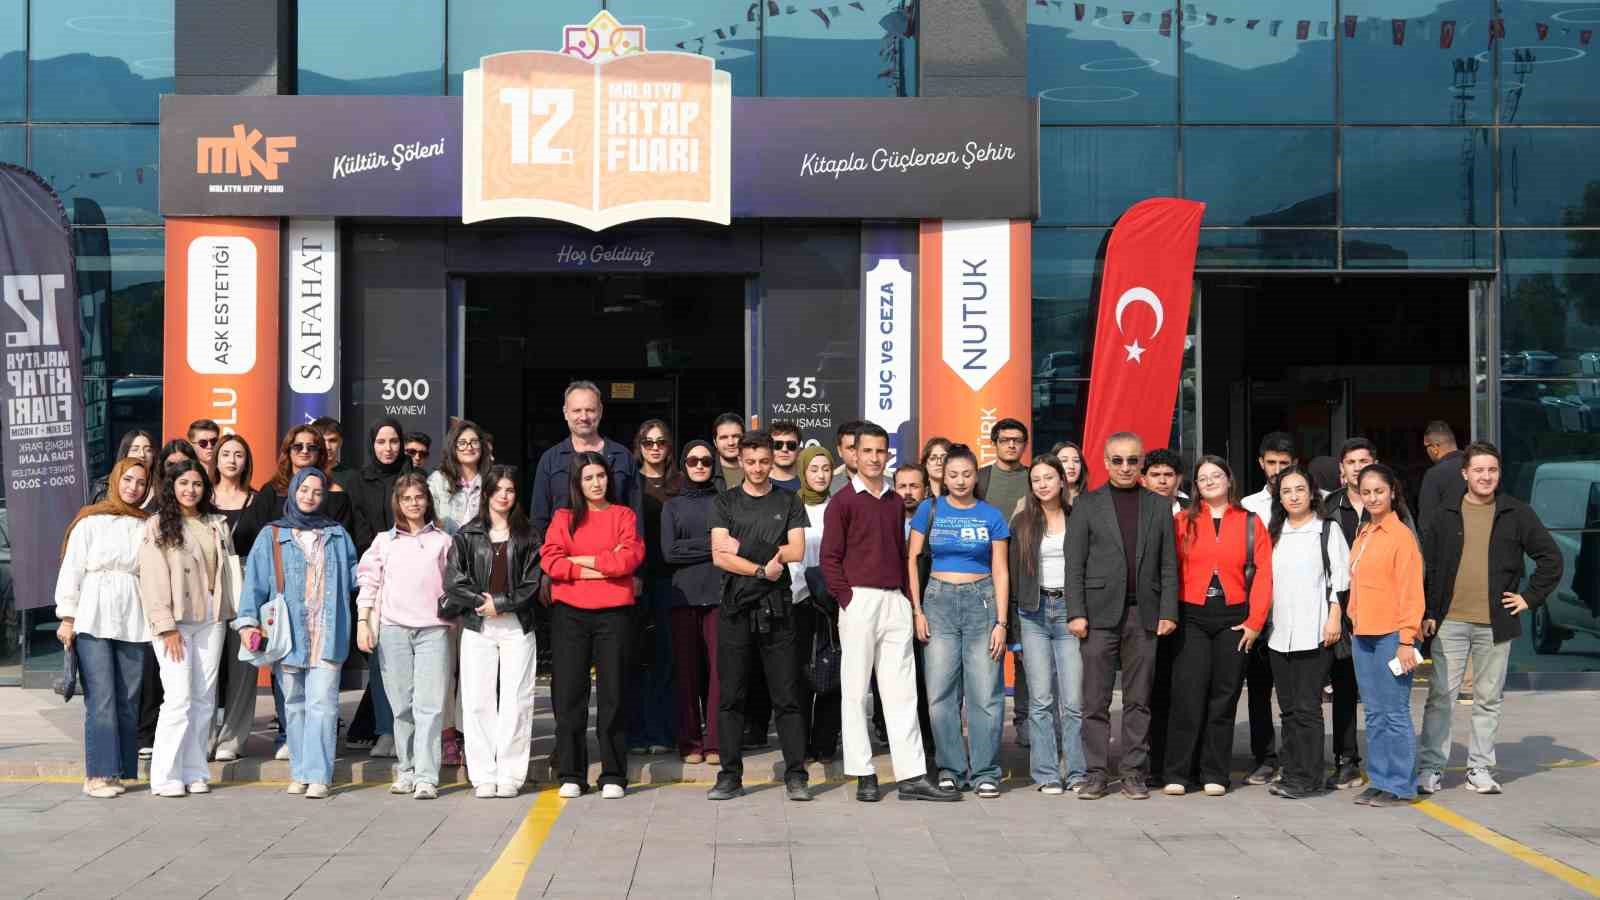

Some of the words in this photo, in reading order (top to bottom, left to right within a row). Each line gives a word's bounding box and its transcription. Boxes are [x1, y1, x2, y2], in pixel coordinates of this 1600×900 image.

[607, 82, 681, 99] MALATYA
[607, 101, 700, 135] KİTAP
[332, 153, 388, 179] Kültür
[391, 137, 445, 170] Şöleni
[607, 138, 699, 173] FUARI
[800, 152, 868, 180] Kitapla
[871, 147, 959, 172] Güçlenen
[962, 141, 1016, 169] Şehir
[556, 244, 587, 266] Hoş
[590, 245, 655, 266] Geldiniz
[212, 245, 230, 325] ESTETİĞİ
[300, 237, 323, 380] SAFAHAT
[879, 282, 894, 334] CEZA
[962, 258, 988, 370] NUTUK
[214, 329, 233, 366] AŞK
[881, 340, 894, 364] ve
[382, 378, 430, 401] 300
[785, 377, 817, 399] 35
[879, 369, 896, 411] SUÇ
[772, 403, 831, 414] YAZAR-STK
